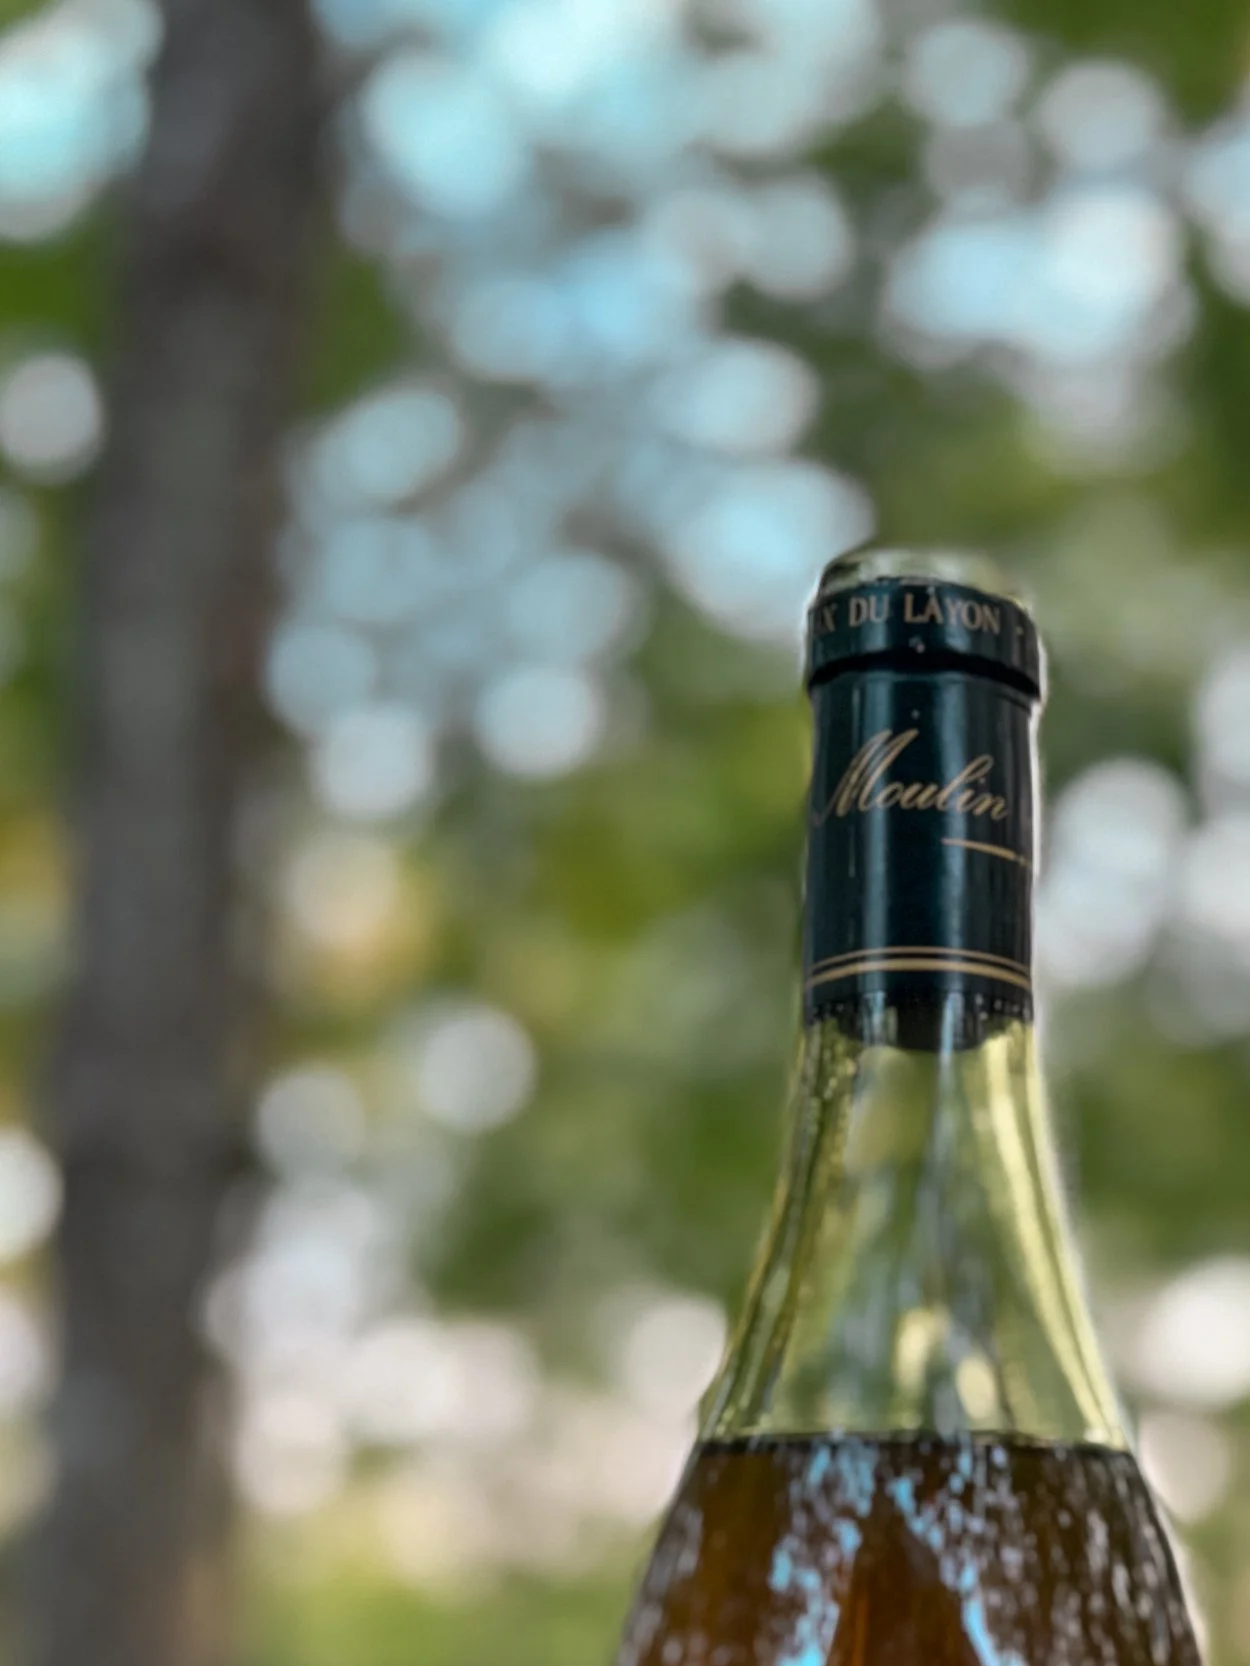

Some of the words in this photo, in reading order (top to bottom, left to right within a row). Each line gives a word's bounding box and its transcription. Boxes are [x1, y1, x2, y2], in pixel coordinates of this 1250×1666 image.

[849, 595, 889, 628] DU
[903, 592, 1000, 634] LAYON
[813, 728, 1009, 826] Moulin
